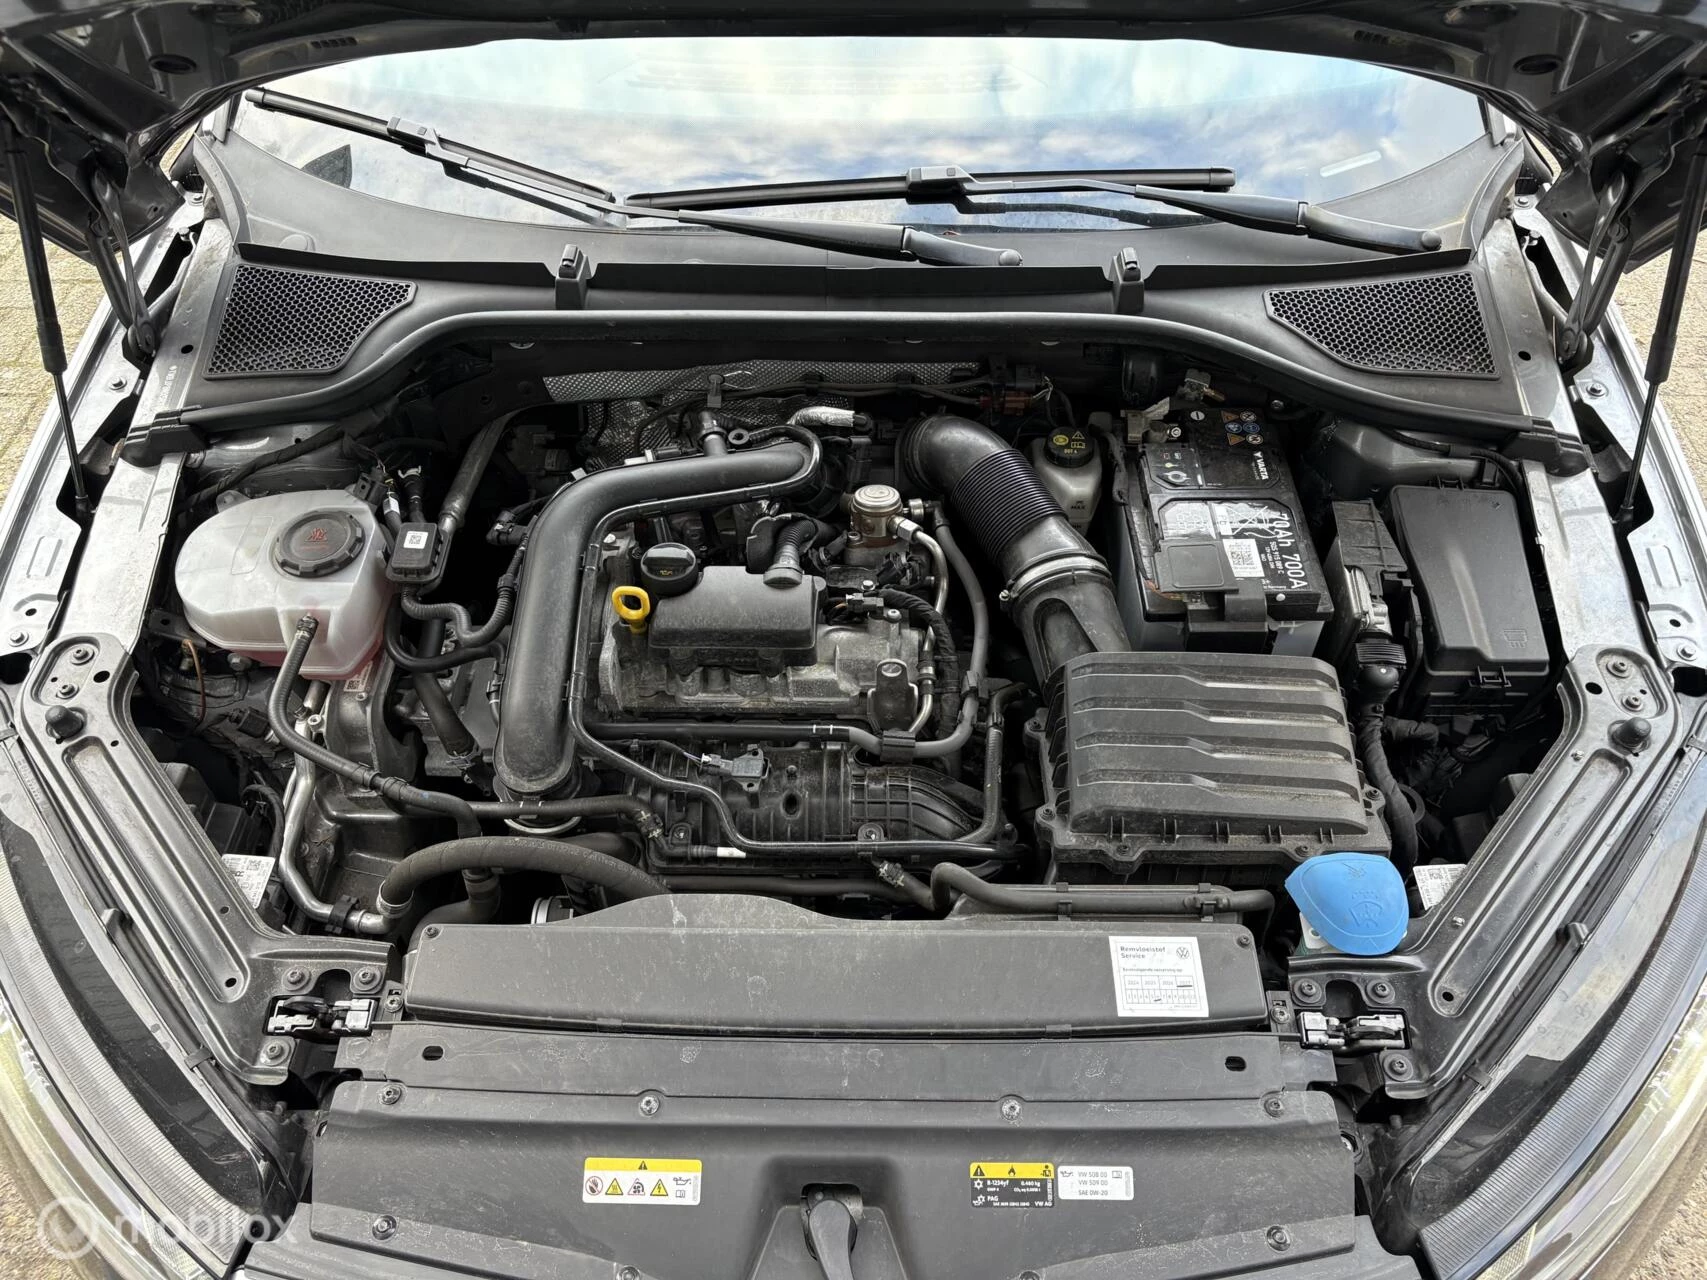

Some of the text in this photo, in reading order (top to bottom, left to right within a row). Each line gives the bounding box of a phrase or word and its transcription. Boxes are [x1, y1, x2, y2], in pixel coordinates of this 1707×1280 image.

[1256, 458, 1269, 480] VARTA
[1271, 512, 1308, 589] 70Ah 700A
